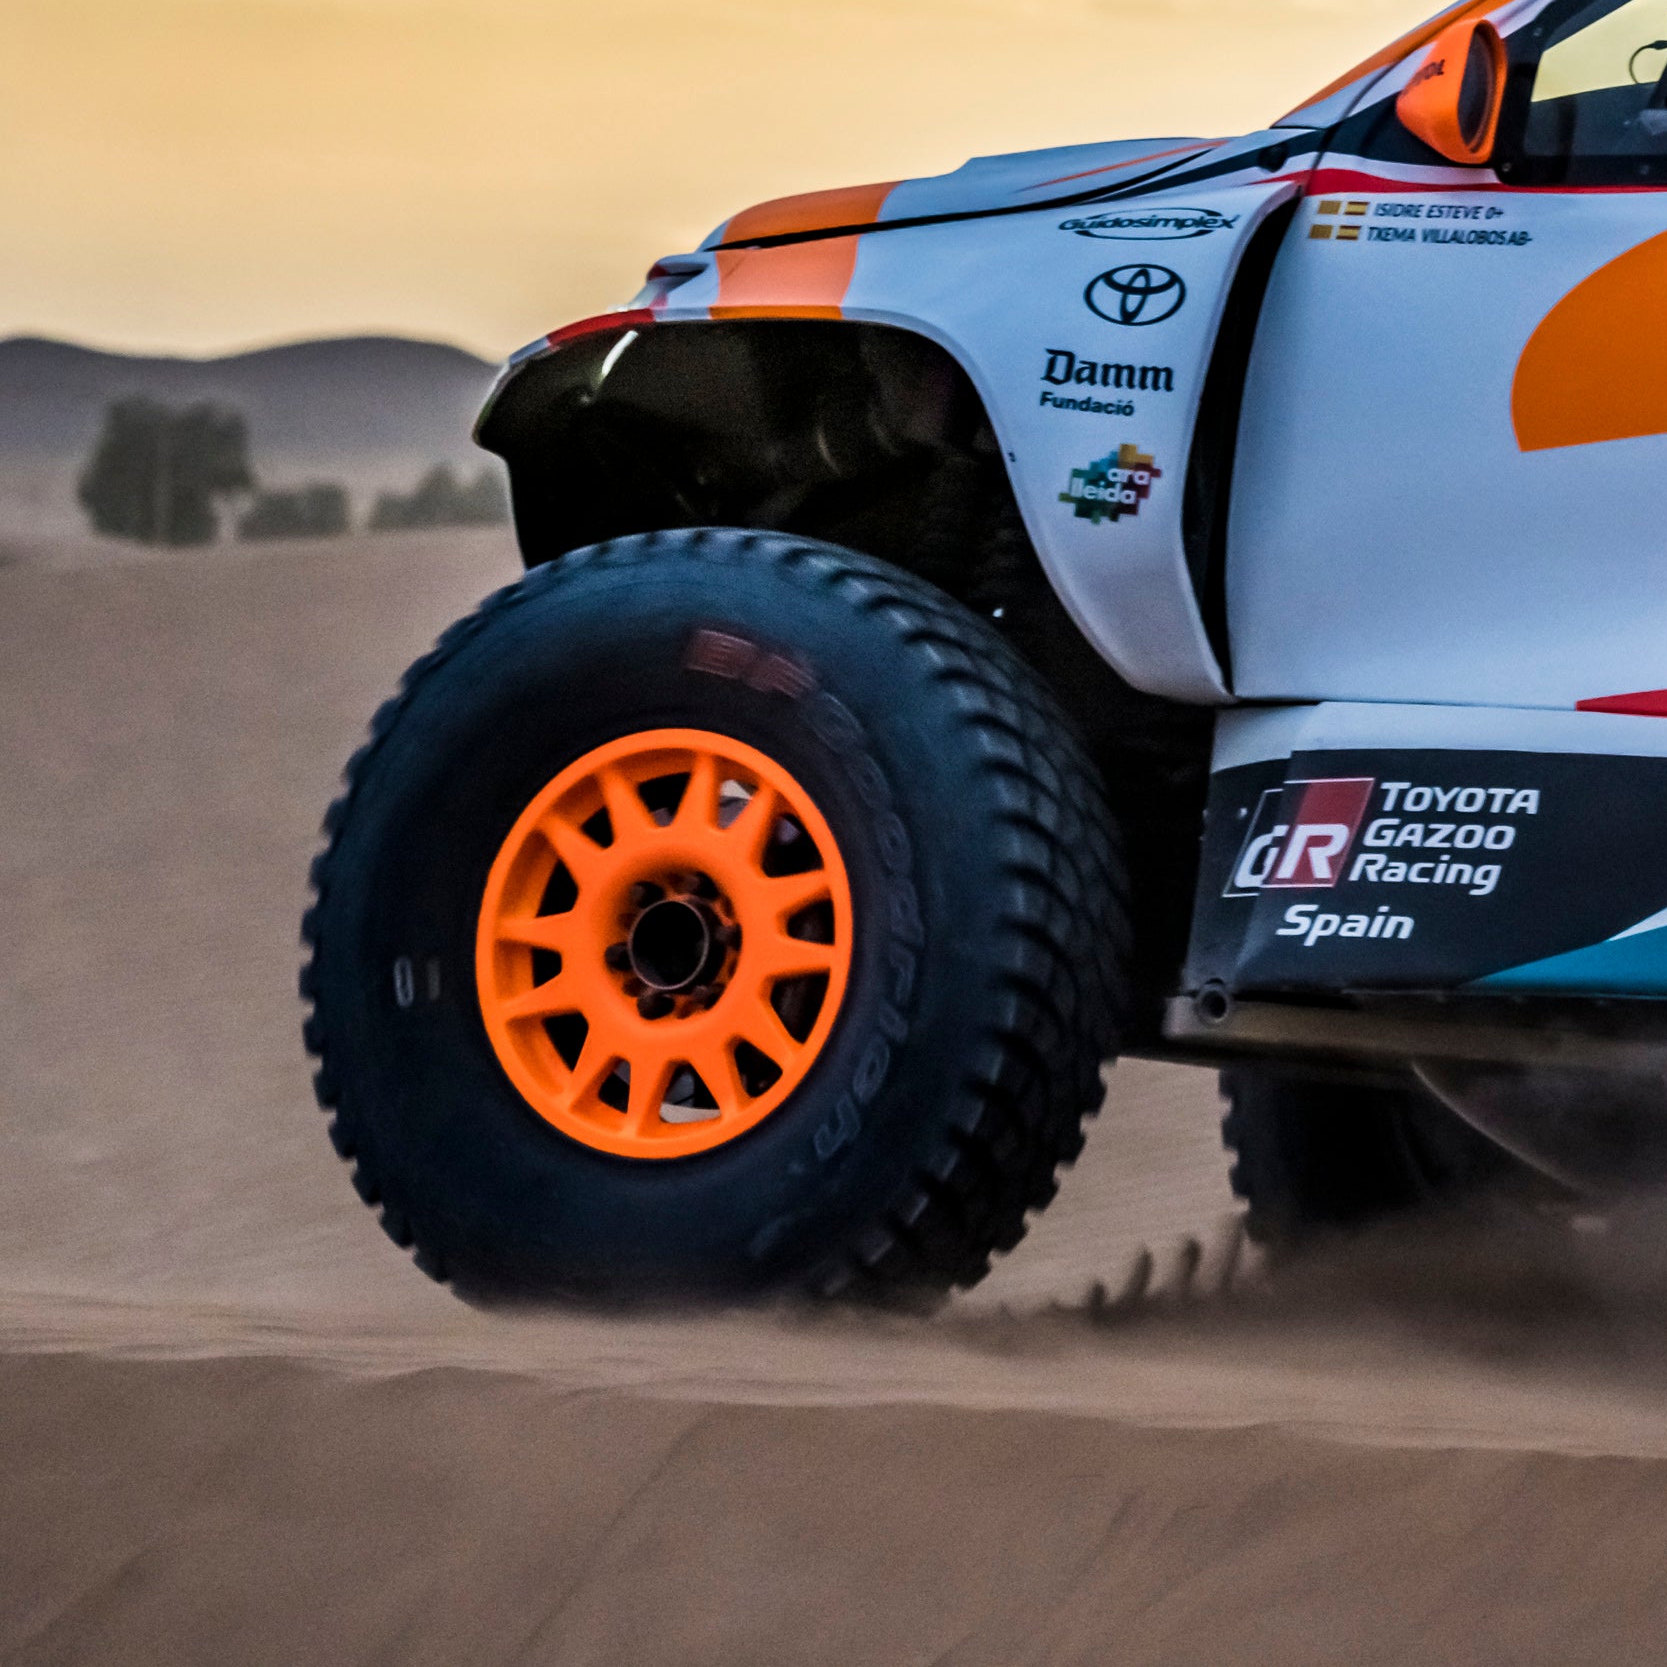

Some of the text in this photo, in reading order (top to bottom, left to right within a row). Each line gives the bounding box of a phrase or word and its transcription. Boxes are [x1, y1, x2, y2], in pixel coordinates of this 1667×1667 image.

[1374, 202, 1421, 218] ISIDRE
[1425, 204, 1481, 220] ESTEVE
[1420, 227, 1506, 245] VILLALOBOS
[1041, 348, 1175, 392] Damm
[1039, 391, 1135, 417] Fundació
[1071, 476, 1138, 505] lleida
[1107, 464, 1150, 486] ara
[1380, 781, 1541, 815] TOYOTA
[1362, 818, 1516, 850] GAZOO
[1234, 823, 1351, 888] GR
[1348, 852, 1503, 896] Racing
[1275, 903, 1415, 946] Spain
